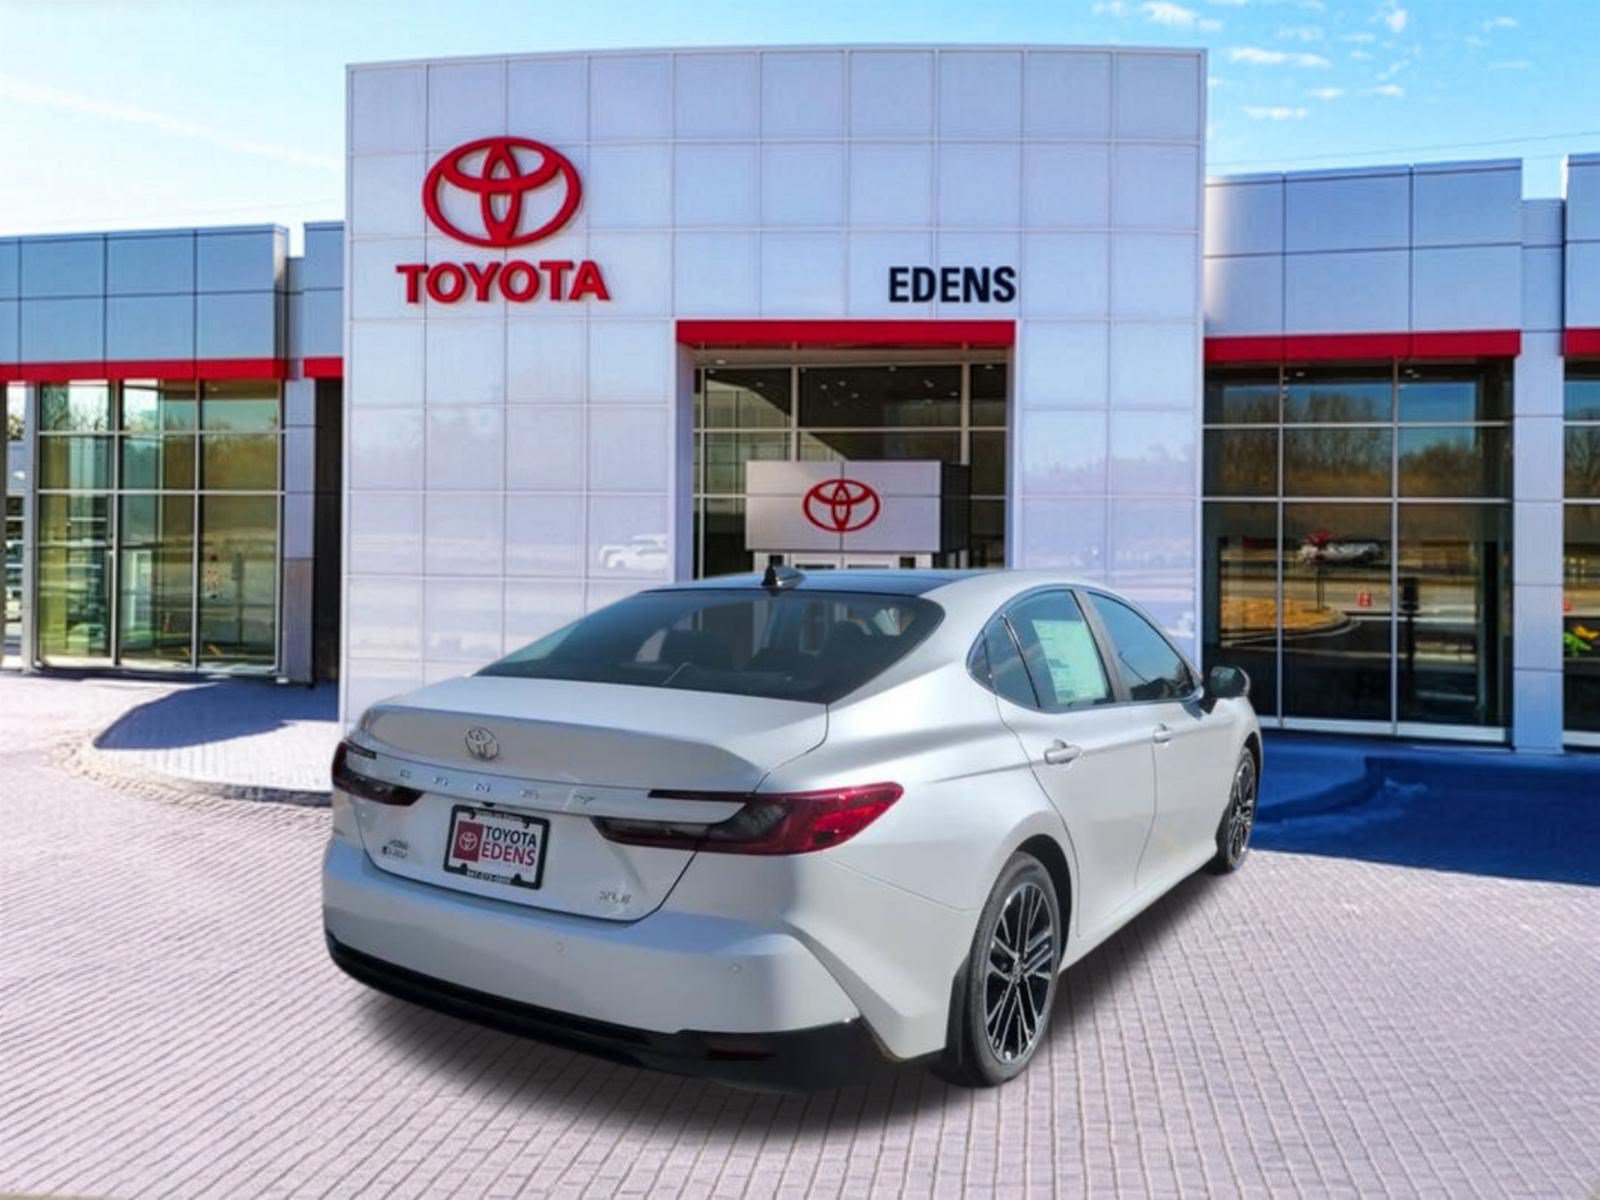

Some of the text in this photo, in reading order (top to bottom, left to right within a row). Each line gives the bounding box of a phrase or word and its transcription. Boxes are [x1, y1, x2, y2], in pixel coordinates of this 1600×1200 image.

[397, 260, 609, 304] TOYOTA
[889, 266, 1016, 303] EDENS
[486, 825, 537, 848] TOYOTA
[481, 841, 536, 866] EDENS
